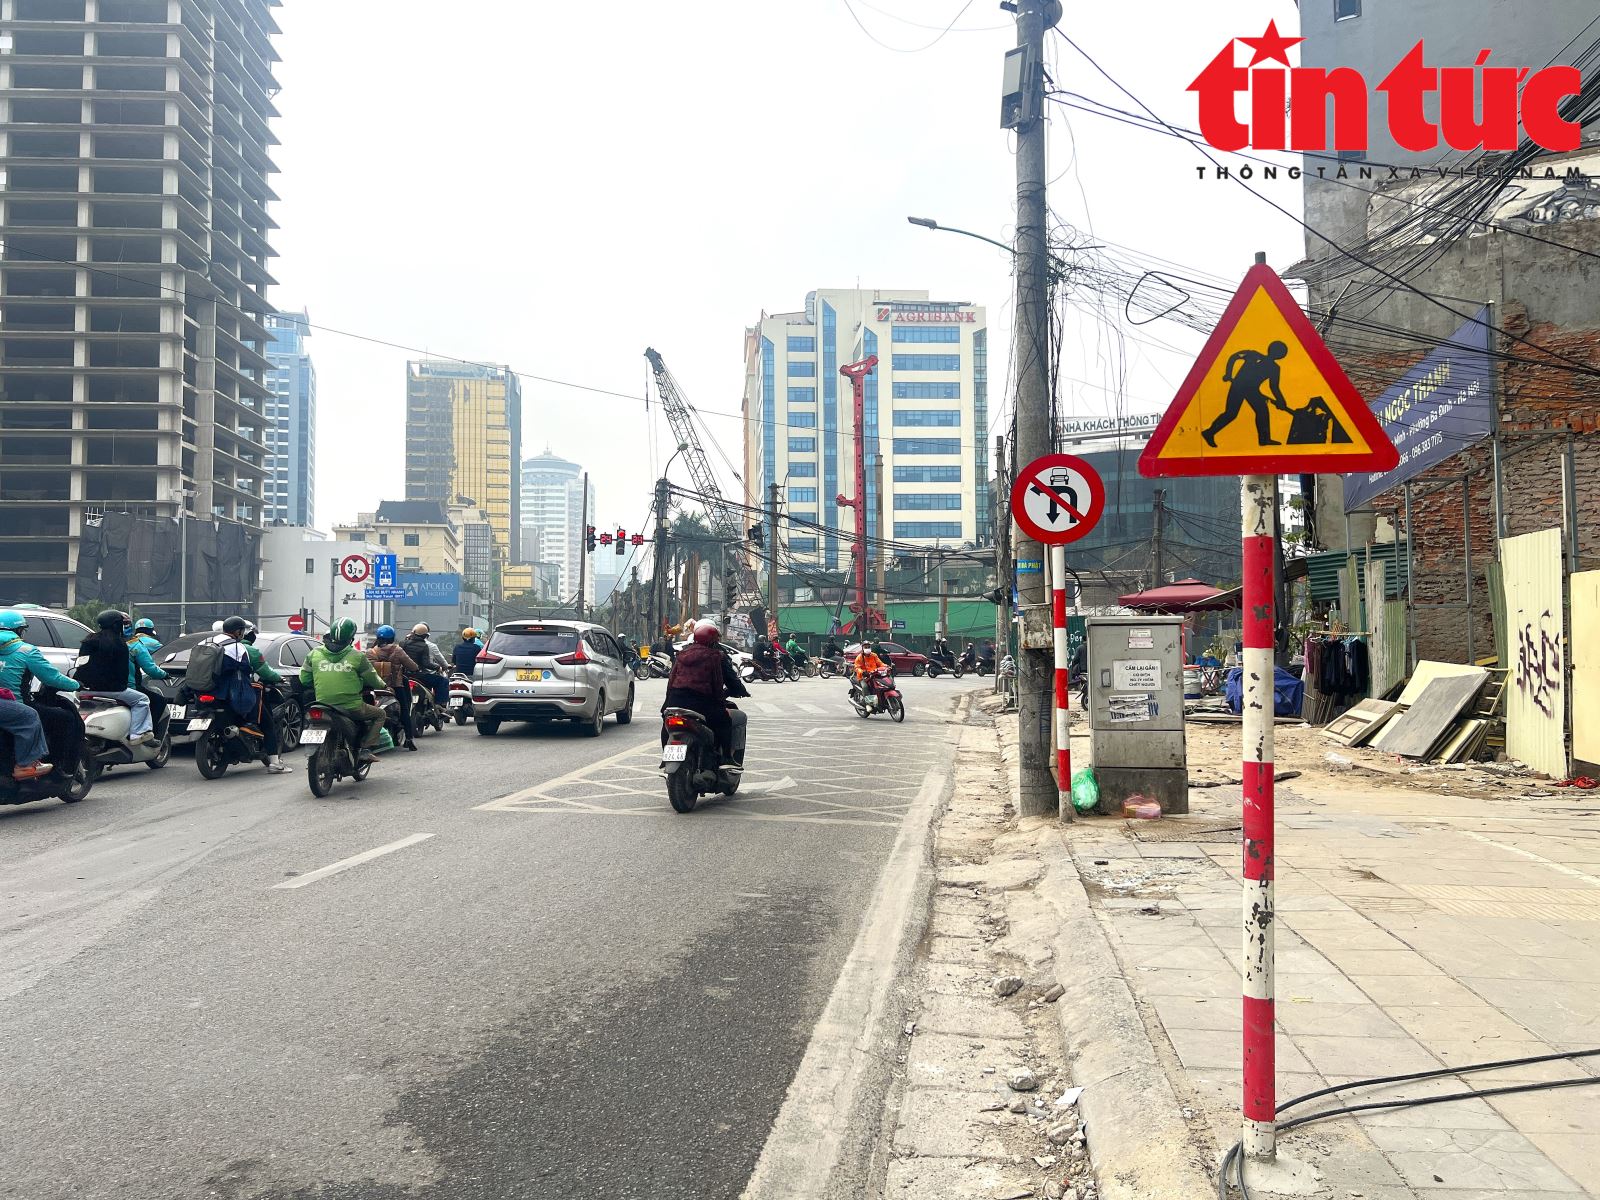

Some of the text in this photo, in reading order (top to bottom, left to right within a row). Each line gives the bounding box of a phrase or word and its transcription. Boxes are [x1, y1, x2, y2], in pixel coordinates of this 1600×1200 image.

[895, 311, 976, 322] AGRIBANK
[1062, 420, 1081, 433] NHÀ
[1084, 418, 1115, 432] KHÁCH
[1118, 415, 1149, 429] THÔNG
[421, 582, 454, 590] APOLLO
[319, 659, 353, 672] Grab
